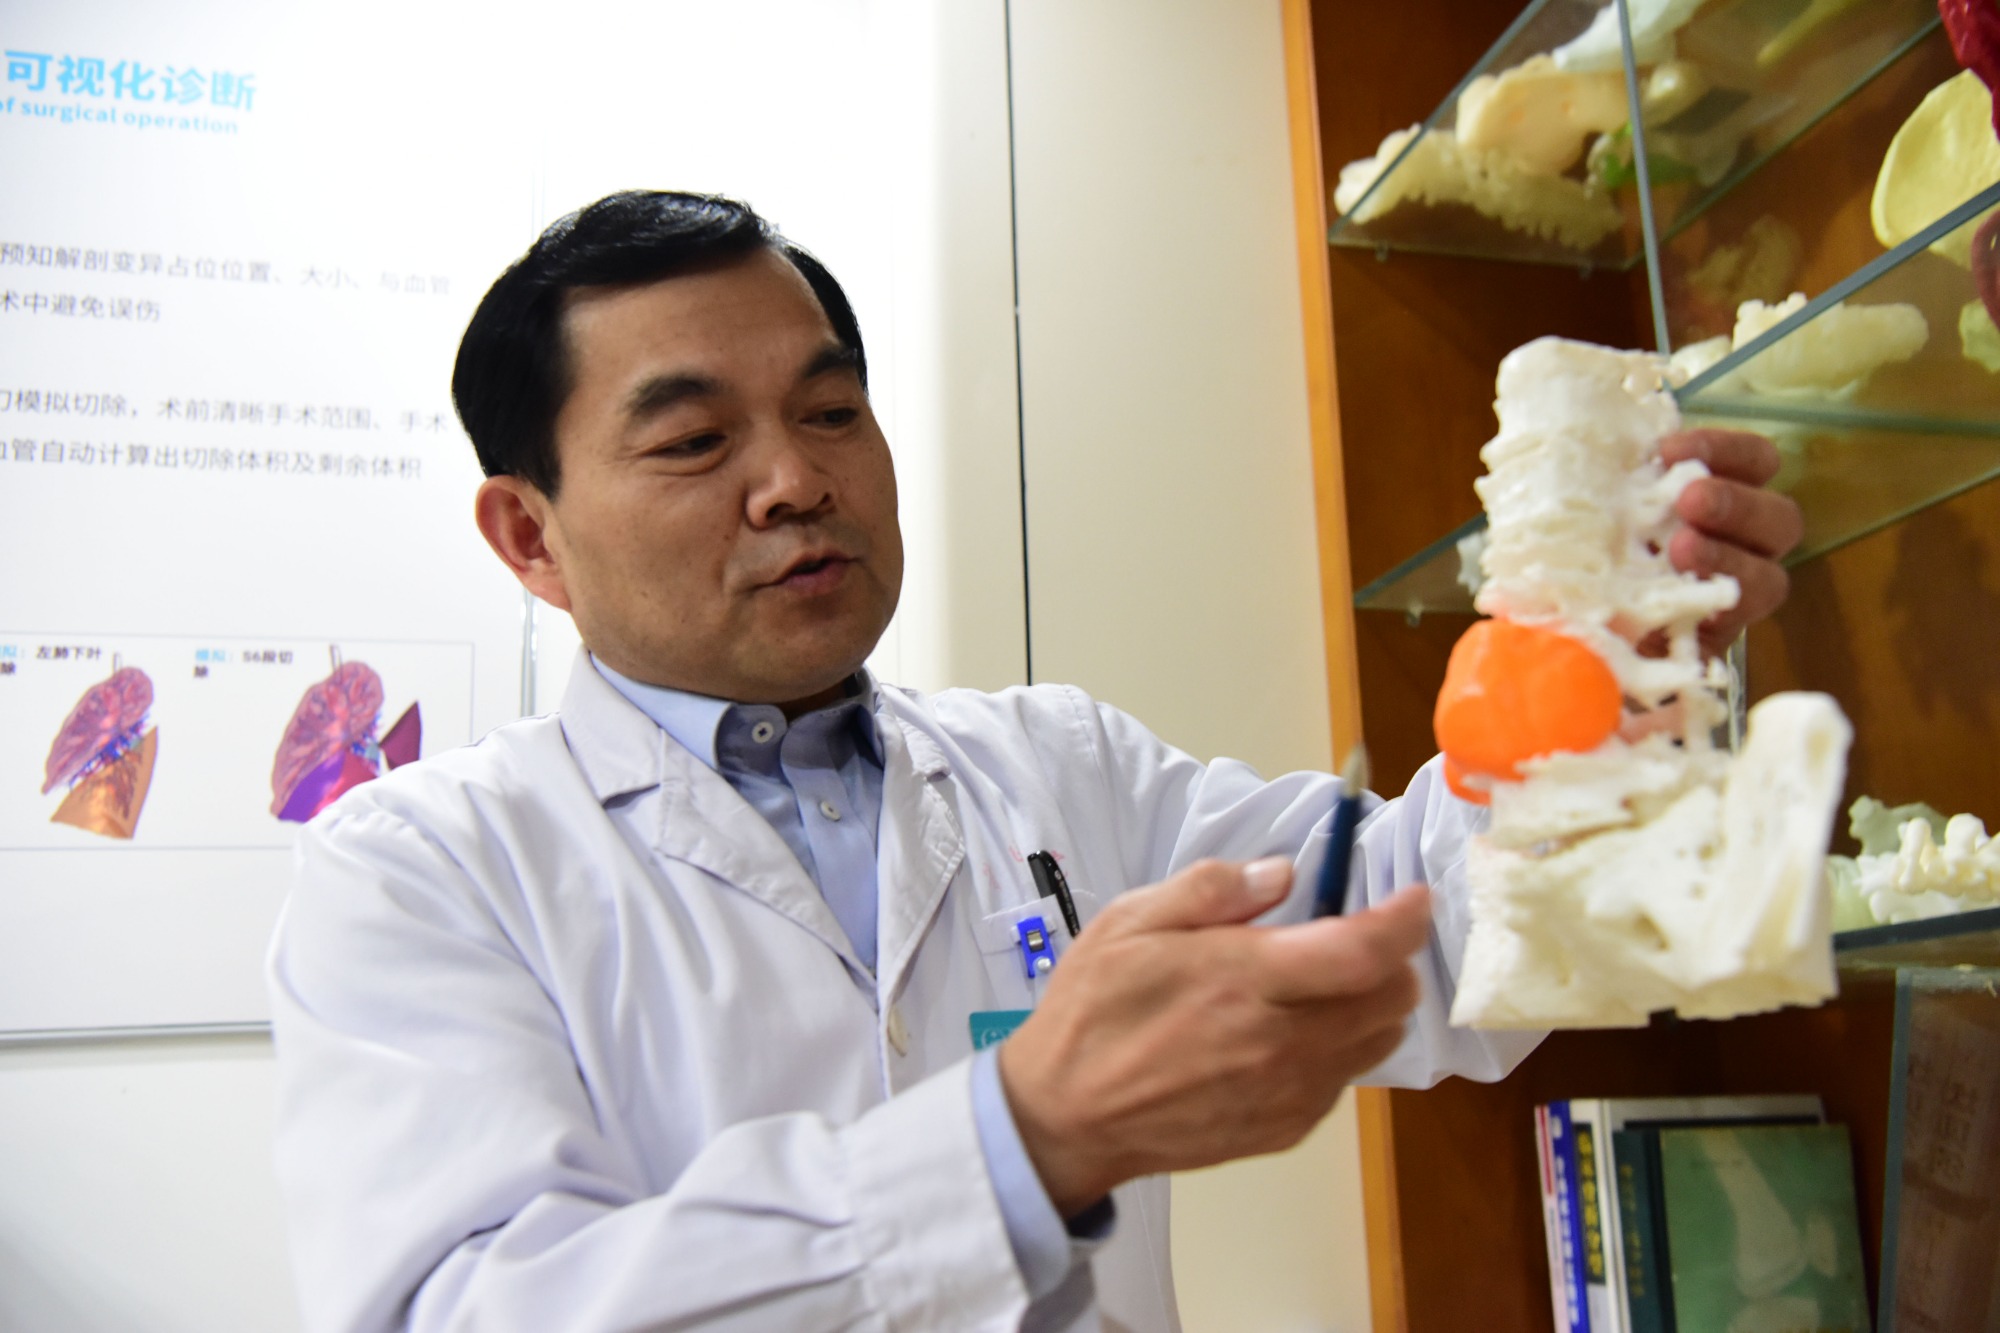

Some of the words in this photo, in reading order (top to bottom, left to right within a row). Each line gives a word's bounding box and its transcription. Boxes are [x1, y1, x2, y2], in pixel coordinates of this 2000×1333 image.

[4, 49, 257, 112] 可视化诊断
[21, 100, 117, 124] surgical
[123, 110, 239, 135] operation
